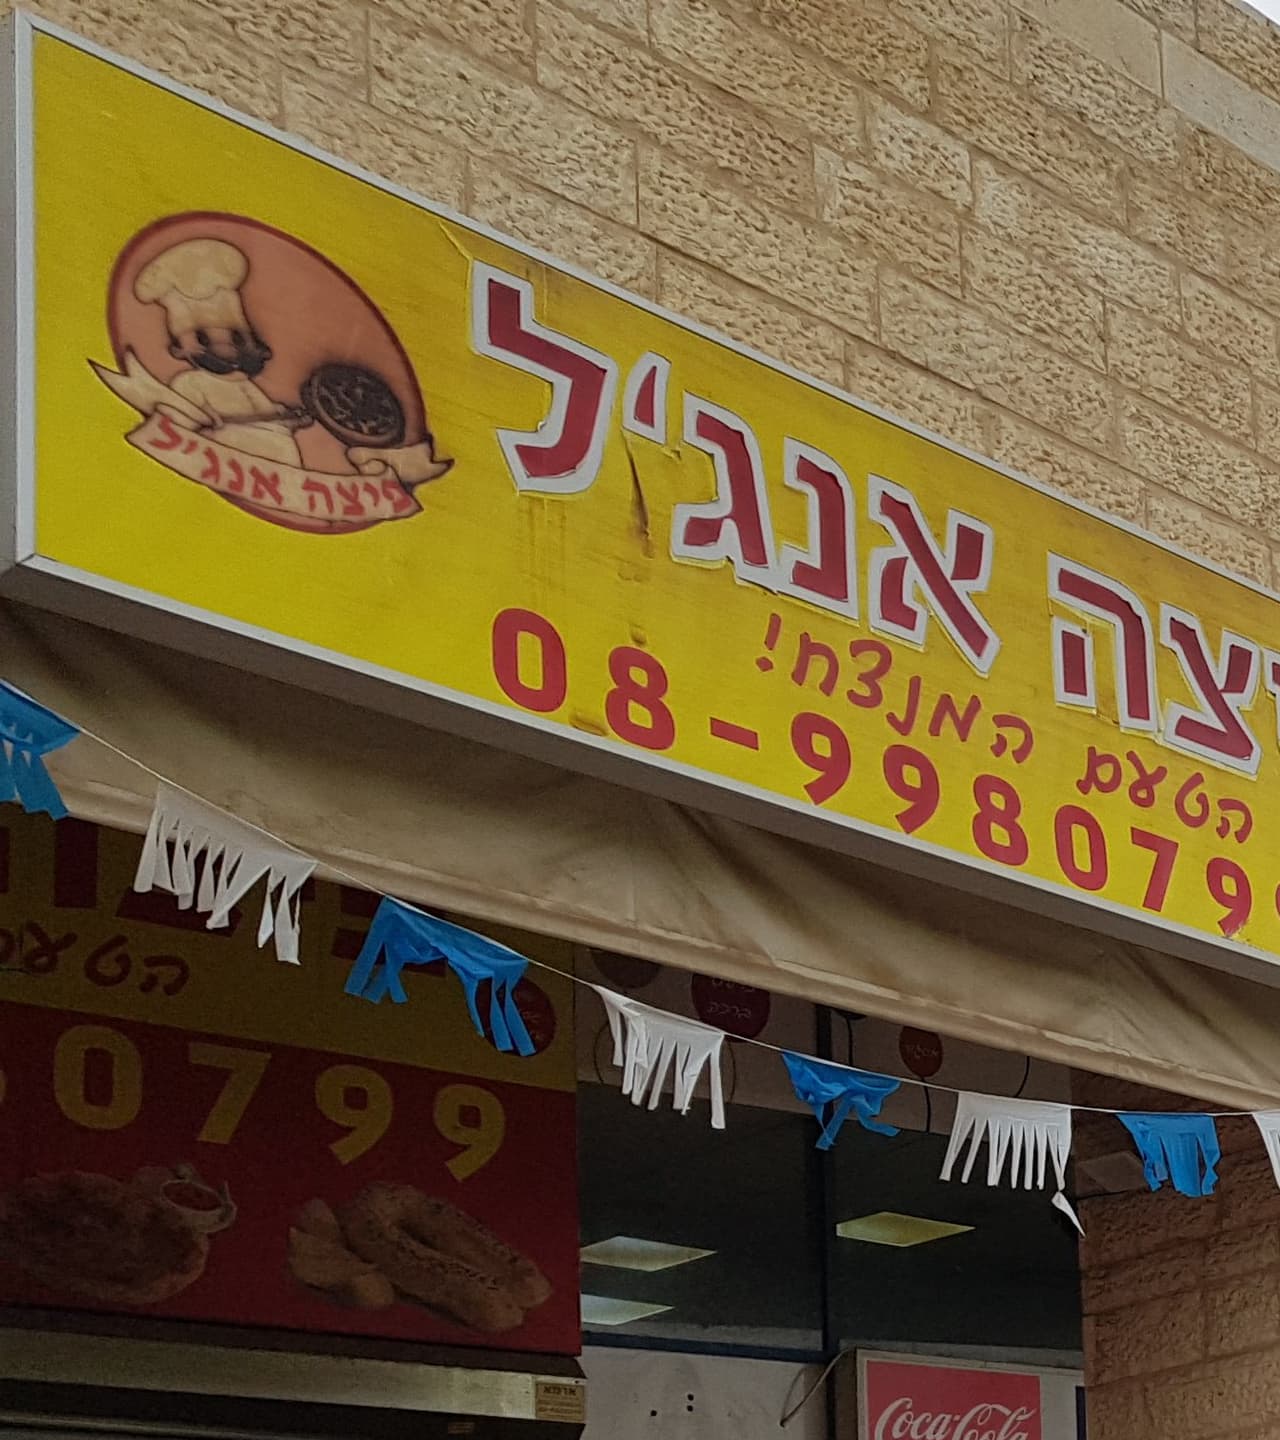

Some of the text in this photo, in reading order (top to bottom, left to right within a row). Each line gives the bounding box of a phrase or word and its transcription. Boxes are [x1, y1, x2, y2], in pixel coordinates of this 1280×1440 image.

[302, 477, 412, 516] פיצה
[1077, 744, 1253, 843] הטעם
[0, 919, 190, 996] הטע
[0, 1023, 508, 1183] 0799
